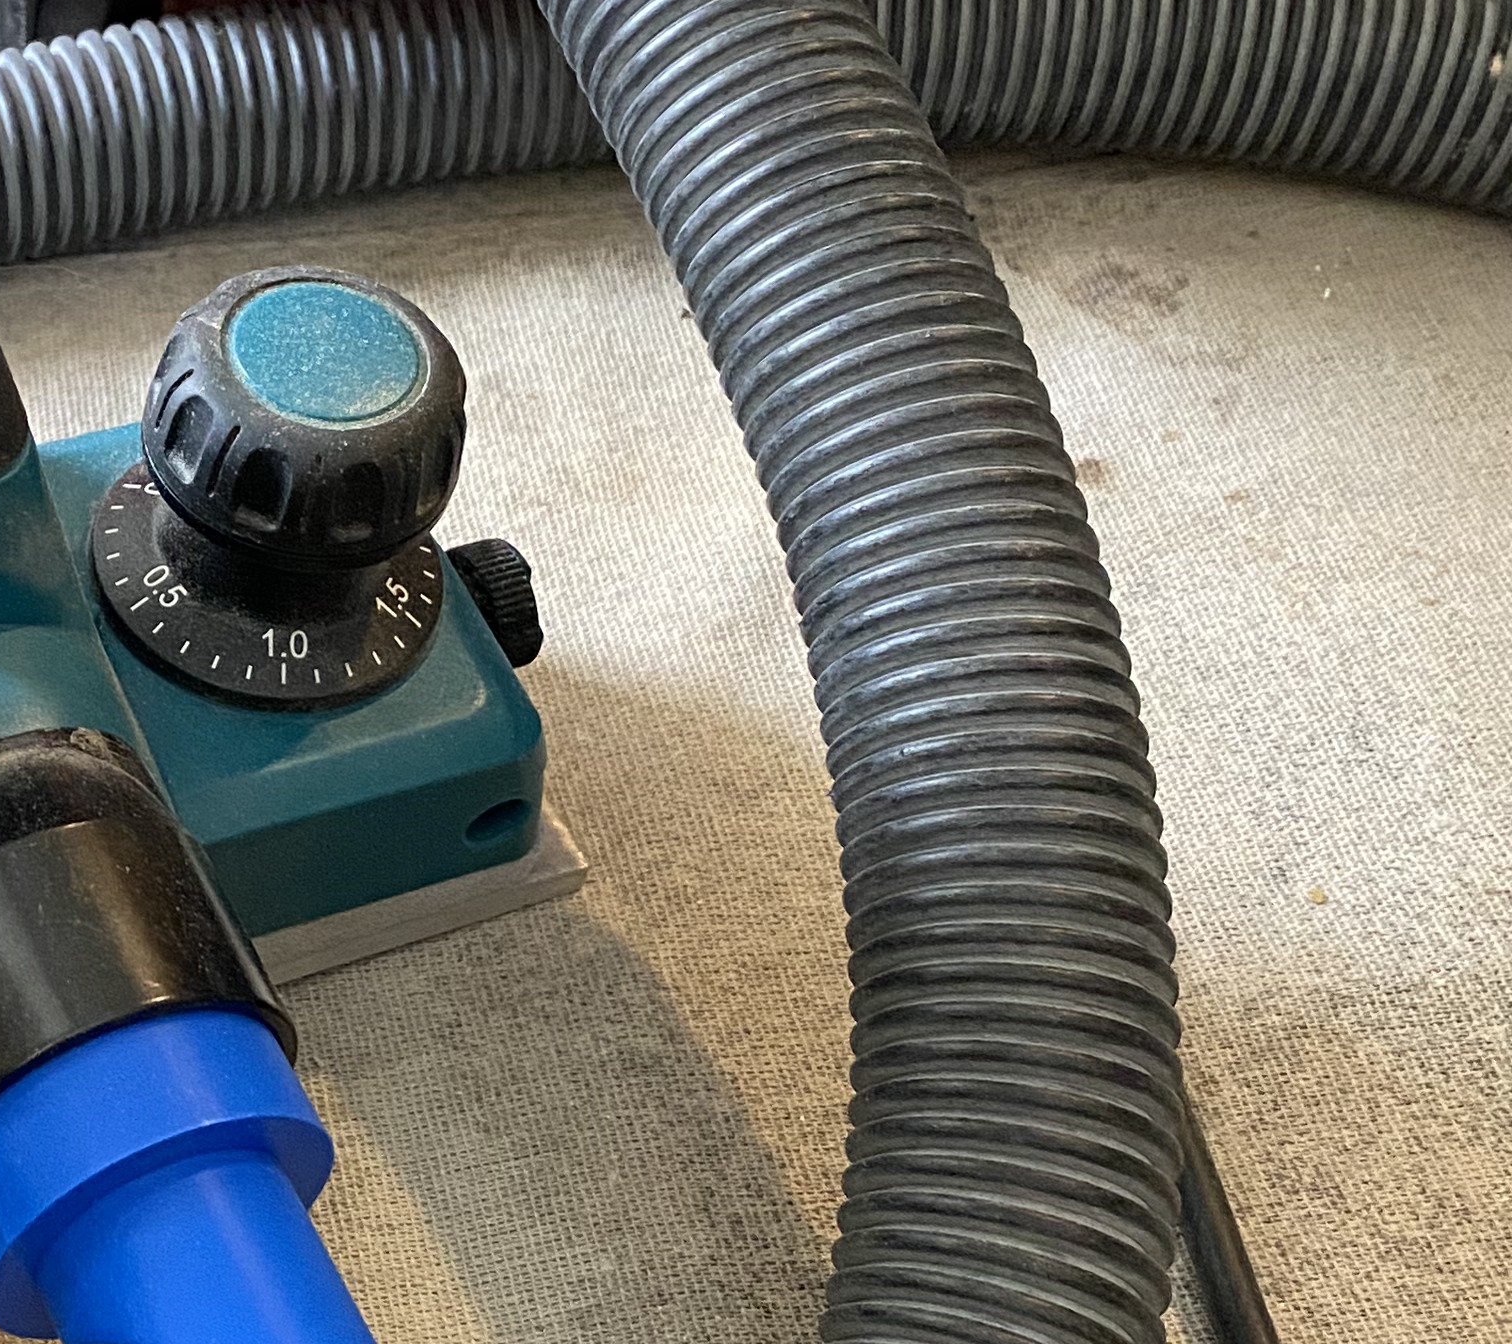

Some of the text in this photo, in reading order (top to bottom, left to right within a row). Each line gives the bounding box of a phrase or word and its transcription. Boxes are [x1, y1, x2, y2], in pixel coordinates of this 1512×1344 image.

[142, 564, 189, 608] 0.5
[375, 577, 411, 617] 1.5
[261, 629, 309, 659] 1.0
